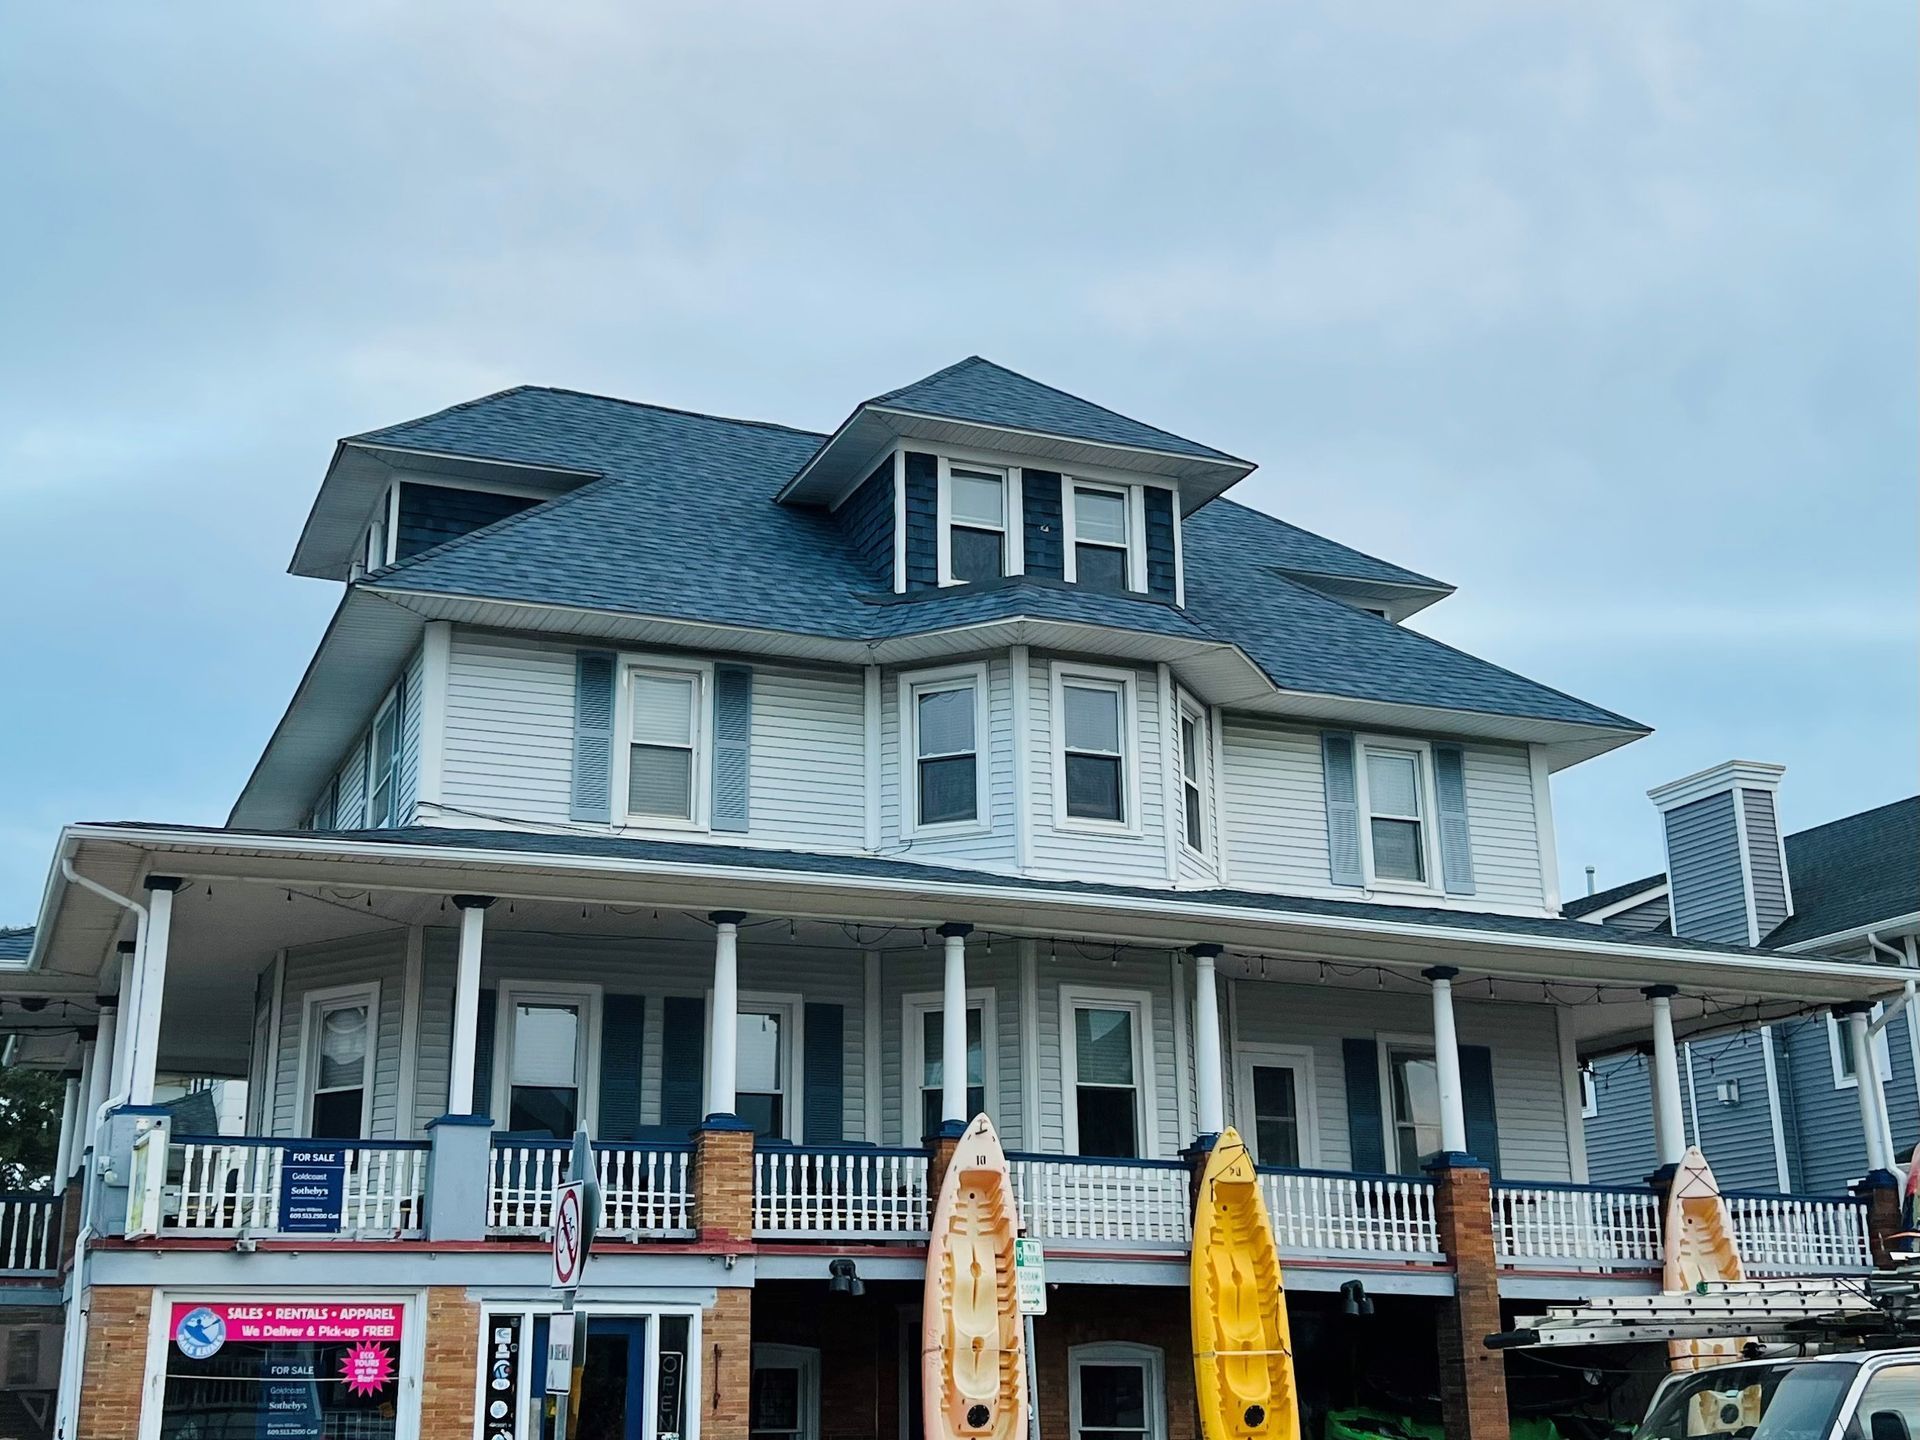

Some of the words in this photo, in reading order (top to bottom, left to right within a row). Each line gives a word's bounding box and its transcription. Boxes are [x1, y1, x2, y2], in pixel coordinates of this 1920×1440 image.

[292, 1153, 311, 1162] FOR
[312, 1153, 336, 1162] SALE
[976, 1155, 986, 1166] 10
[292, 1172, 327, 1181] Goldcoast
[291, 1186, 328, 1196] Sotheby's
[227, 1307, 264, 1320] SALES
[275, 1307, 329, 1320] RENTALS
[339, 1308, 396, 1320] APPAREL
[241, 1325, 260, 1337] We
[263, 1325, 304, 1337] Deliver
[306, 1325, 315, 1337] &
[318, 1325, 360, 1338] Pick-up
[362, 1325, 394, 1337] FREE!
[359, 1351, 375, 1360] ECO
[354, 1359, 380, 1367] TOURS
[271, 1366, 290, 1375] FOR
[291, 1366, 315, 1375] SALE
[270, 1386, 307, 1394] Goldcoast
[660, 1356, 677, 1431] OPEN
[268, 1401, 308, 1411] Sotheby's
